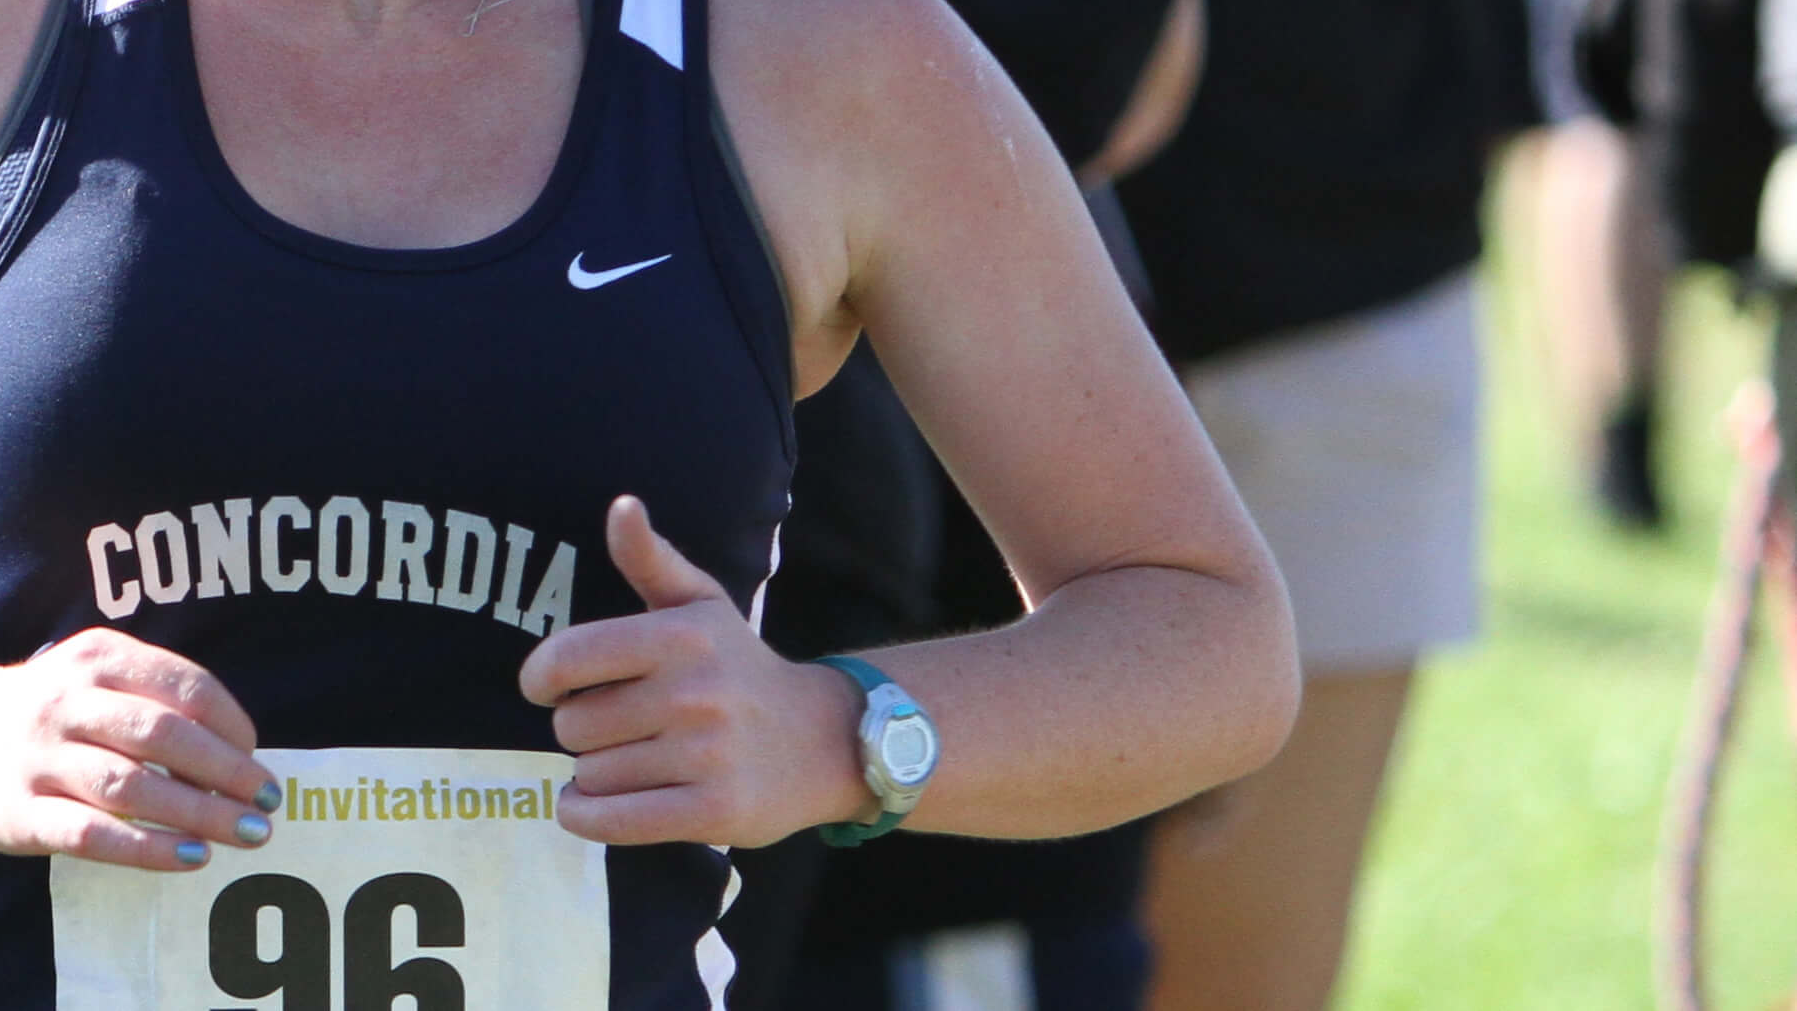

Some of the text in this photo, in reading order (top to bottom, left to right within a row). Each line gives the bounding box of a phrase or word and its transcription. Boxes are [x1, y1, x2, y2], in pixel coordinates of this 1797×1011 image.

[86, 495, 578, 638] CONCORDIA
[286, 777, 552, 821] Invitational
[209, 872, 465, 1011] 96
